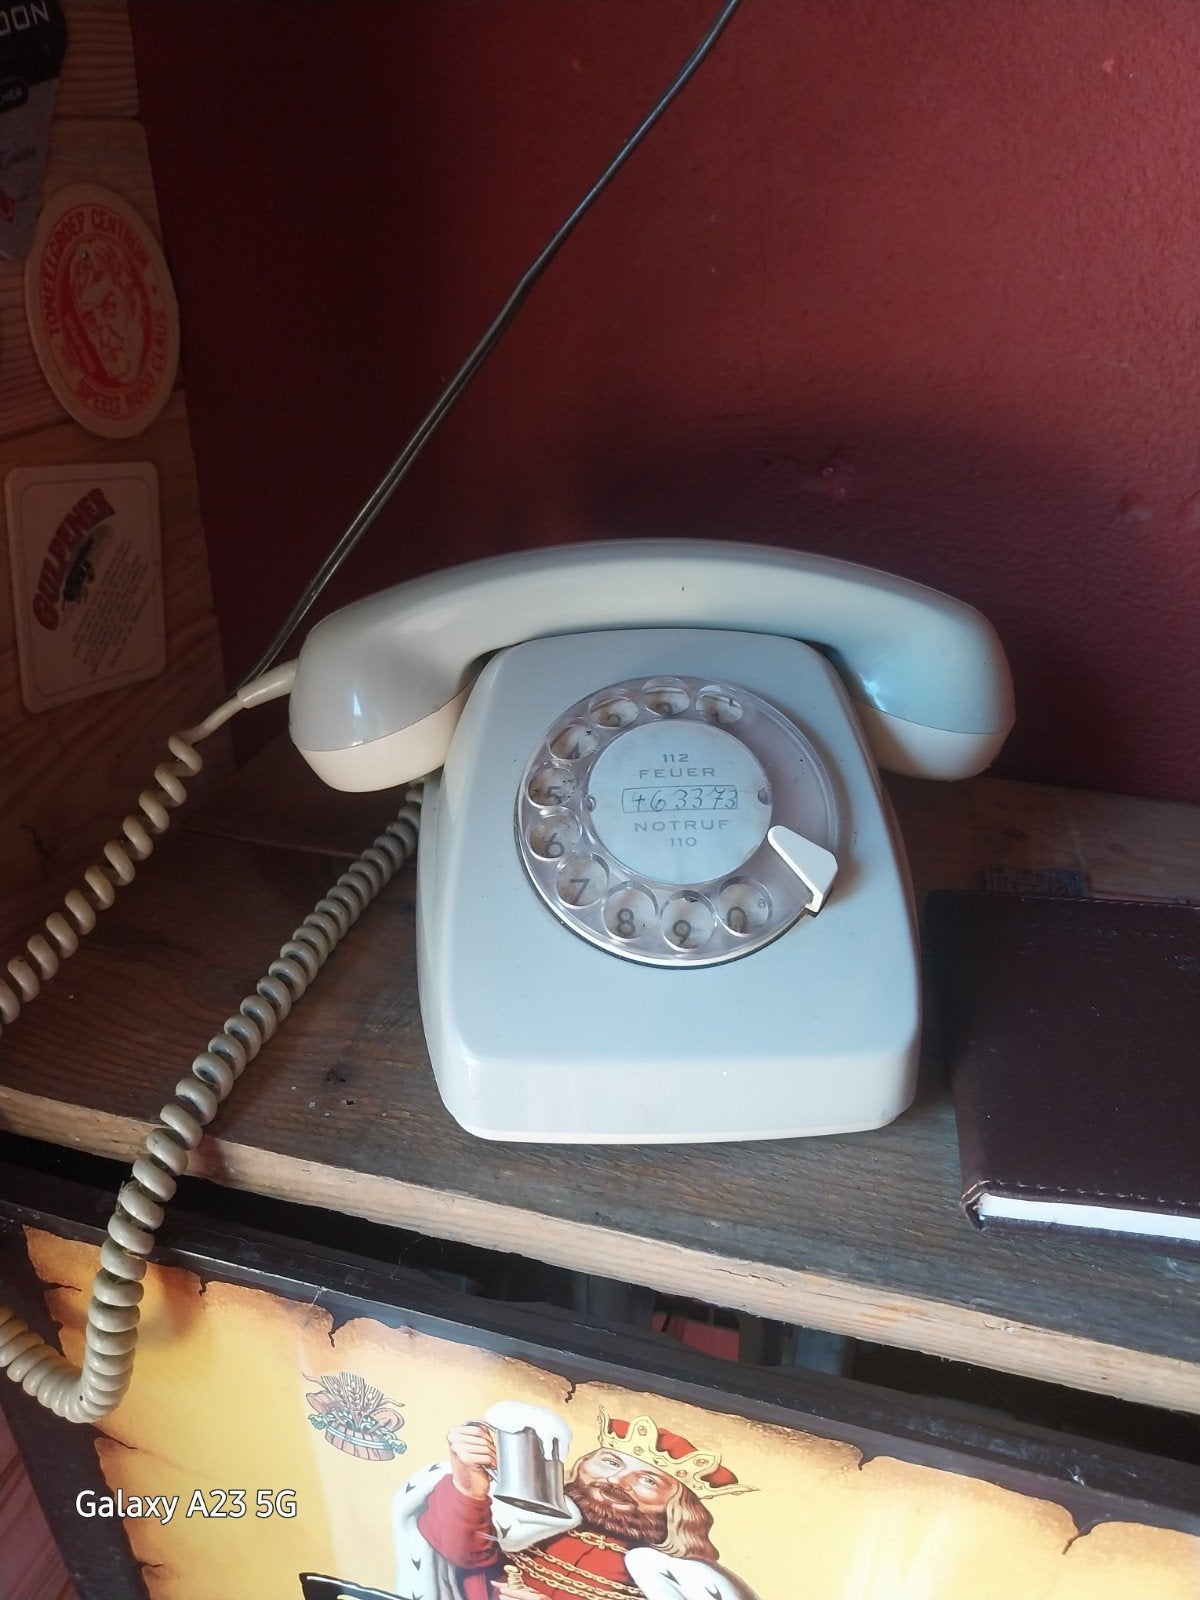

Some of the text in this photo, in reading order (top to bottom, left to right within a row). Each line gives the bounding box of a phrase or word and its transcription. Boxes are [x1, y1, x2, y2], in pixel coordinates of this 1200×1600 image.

[662, 753, 689, 763] 112
[639, 767, 716, 779] FEUER
[634, 820, 730, 832] NOTRUF
[546, 832, 565, 858] 6
[670, 837, 697, 848] 110
[570, 878, 591, 904] 7
[616, 907, 636, 937] 8
[672, 919, 692, 946] 9
